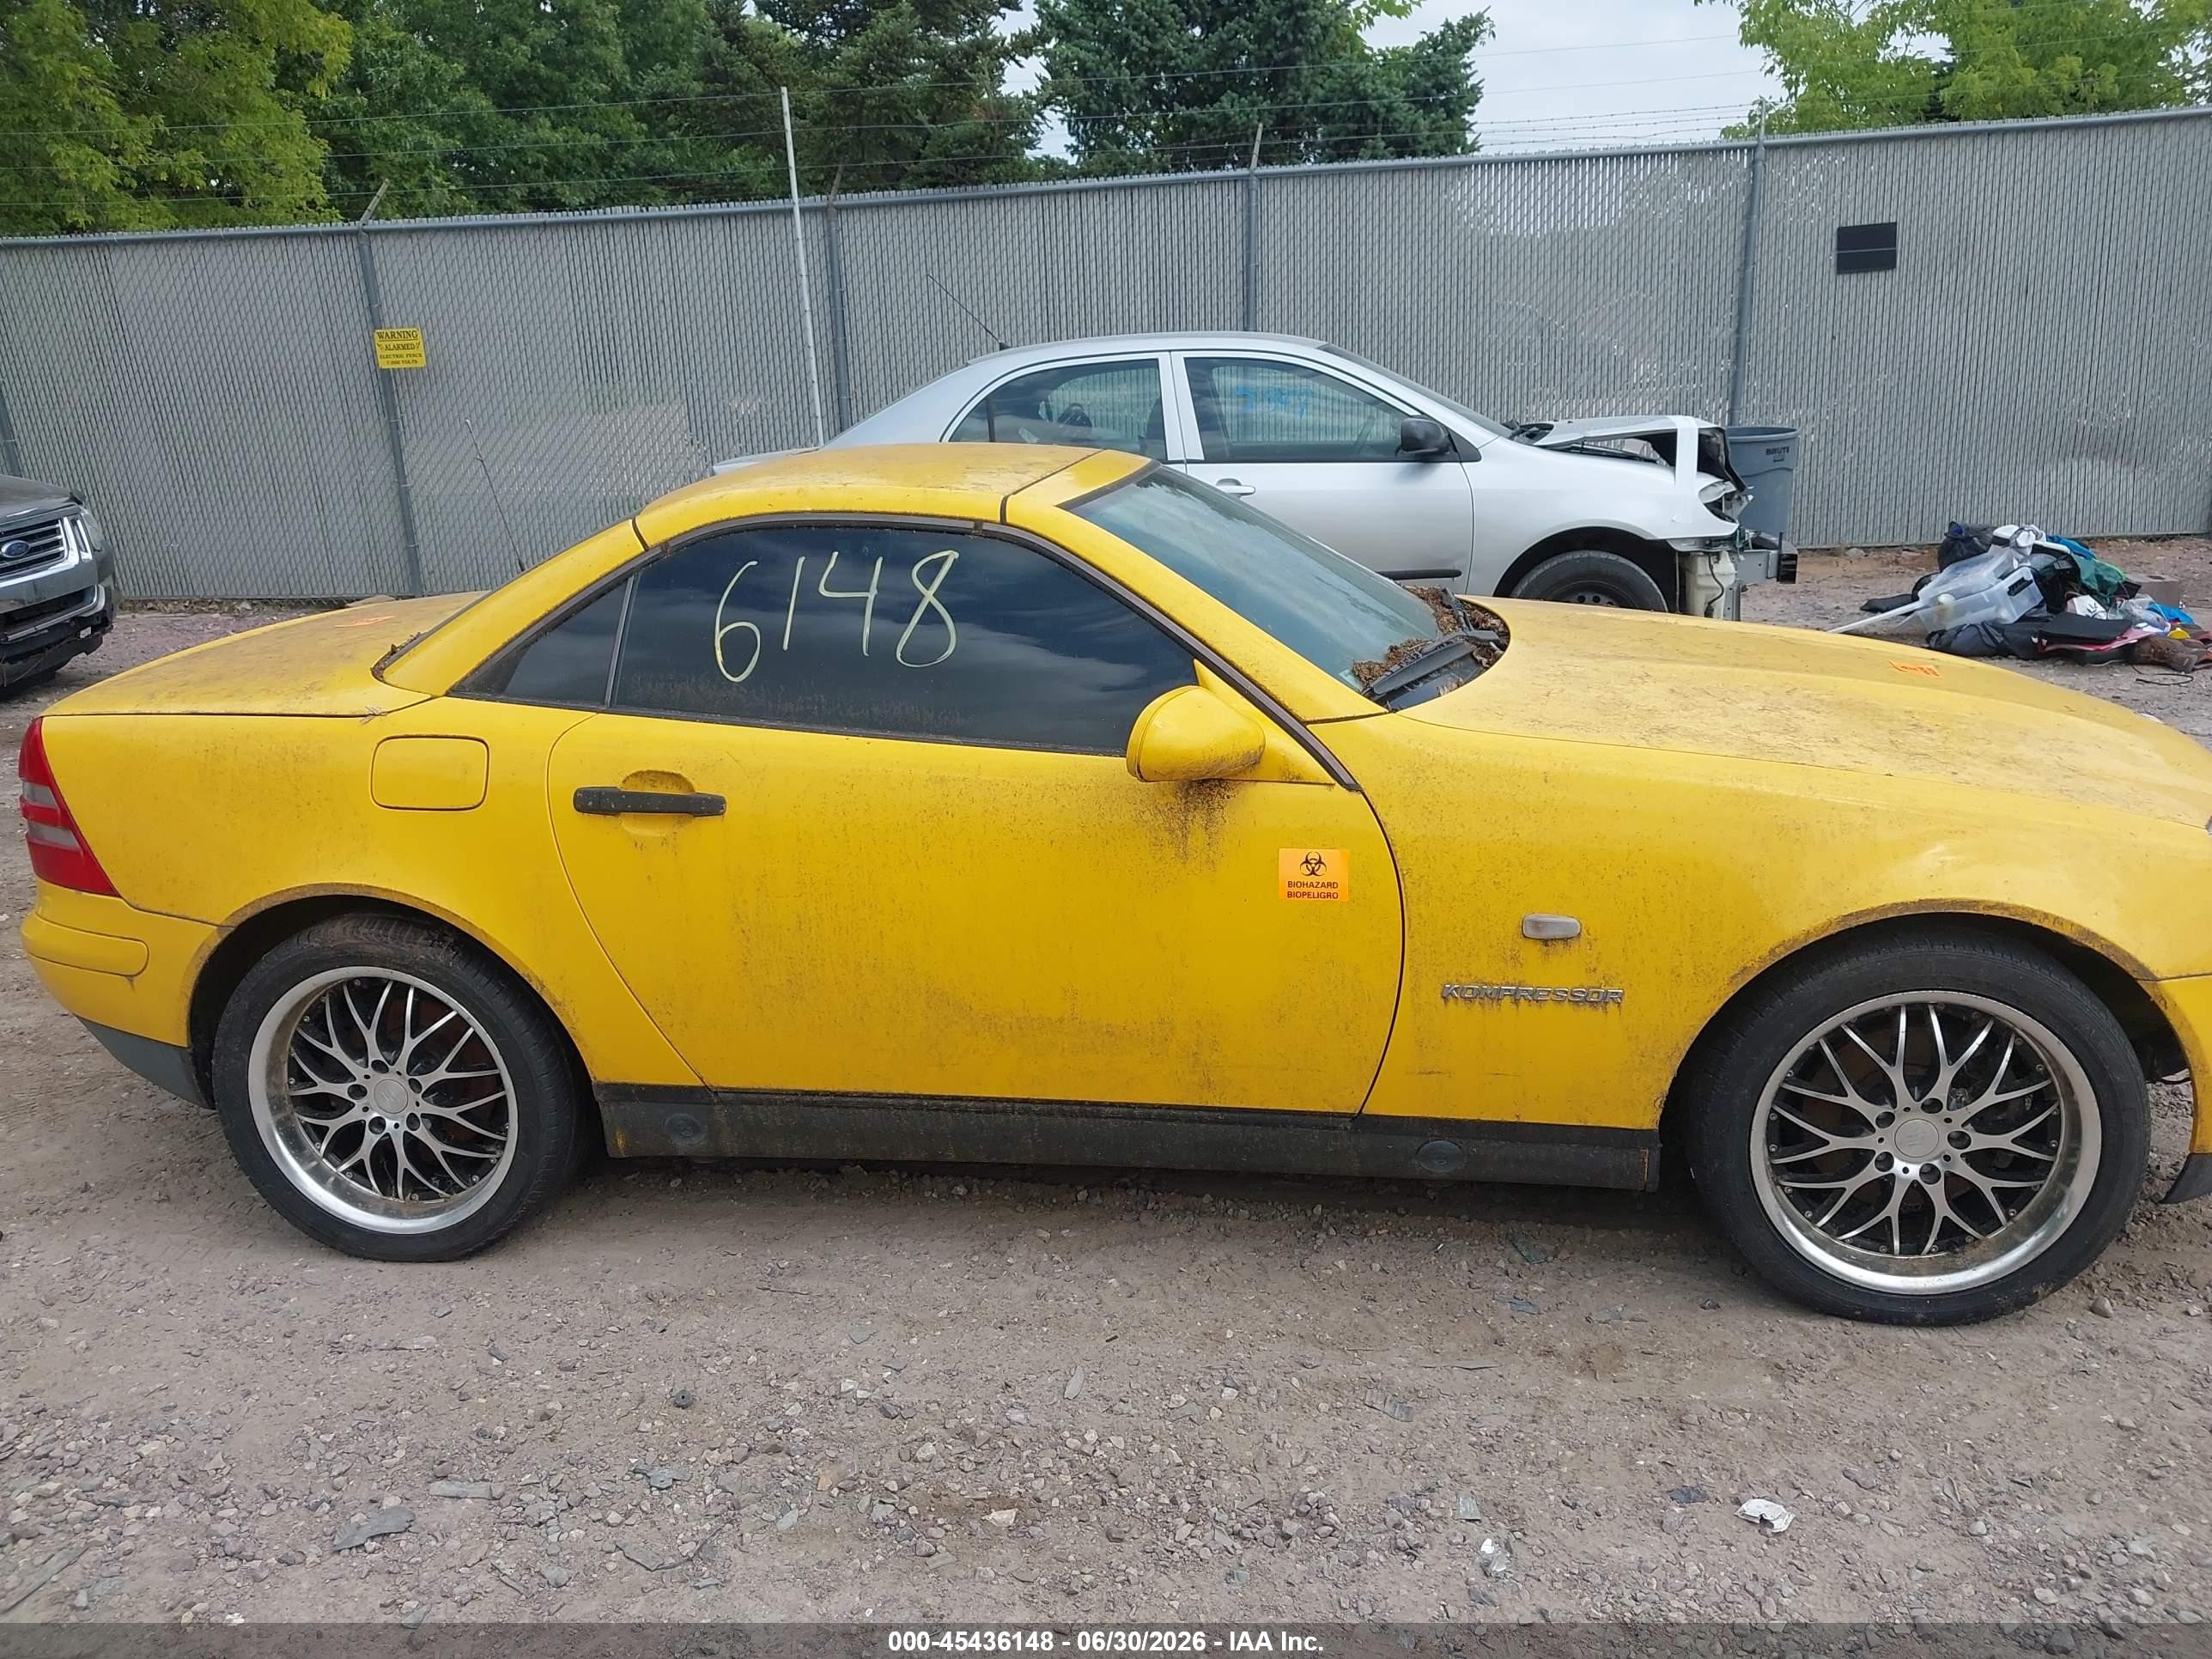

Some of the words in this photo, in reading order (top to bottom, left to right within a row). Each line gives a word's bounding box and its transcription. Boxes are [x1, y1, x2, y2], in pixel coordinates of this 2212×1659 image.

[377, 331, 418, 339] WARNING
[714, 550, 960, 683] 6148
[1287, 880, 1339, 889] BIOHAZARD
[1286, 890, 1339, 899] BIOPELIGRO
[1442, 984, 1624, 1003] KOMPRESSOR
